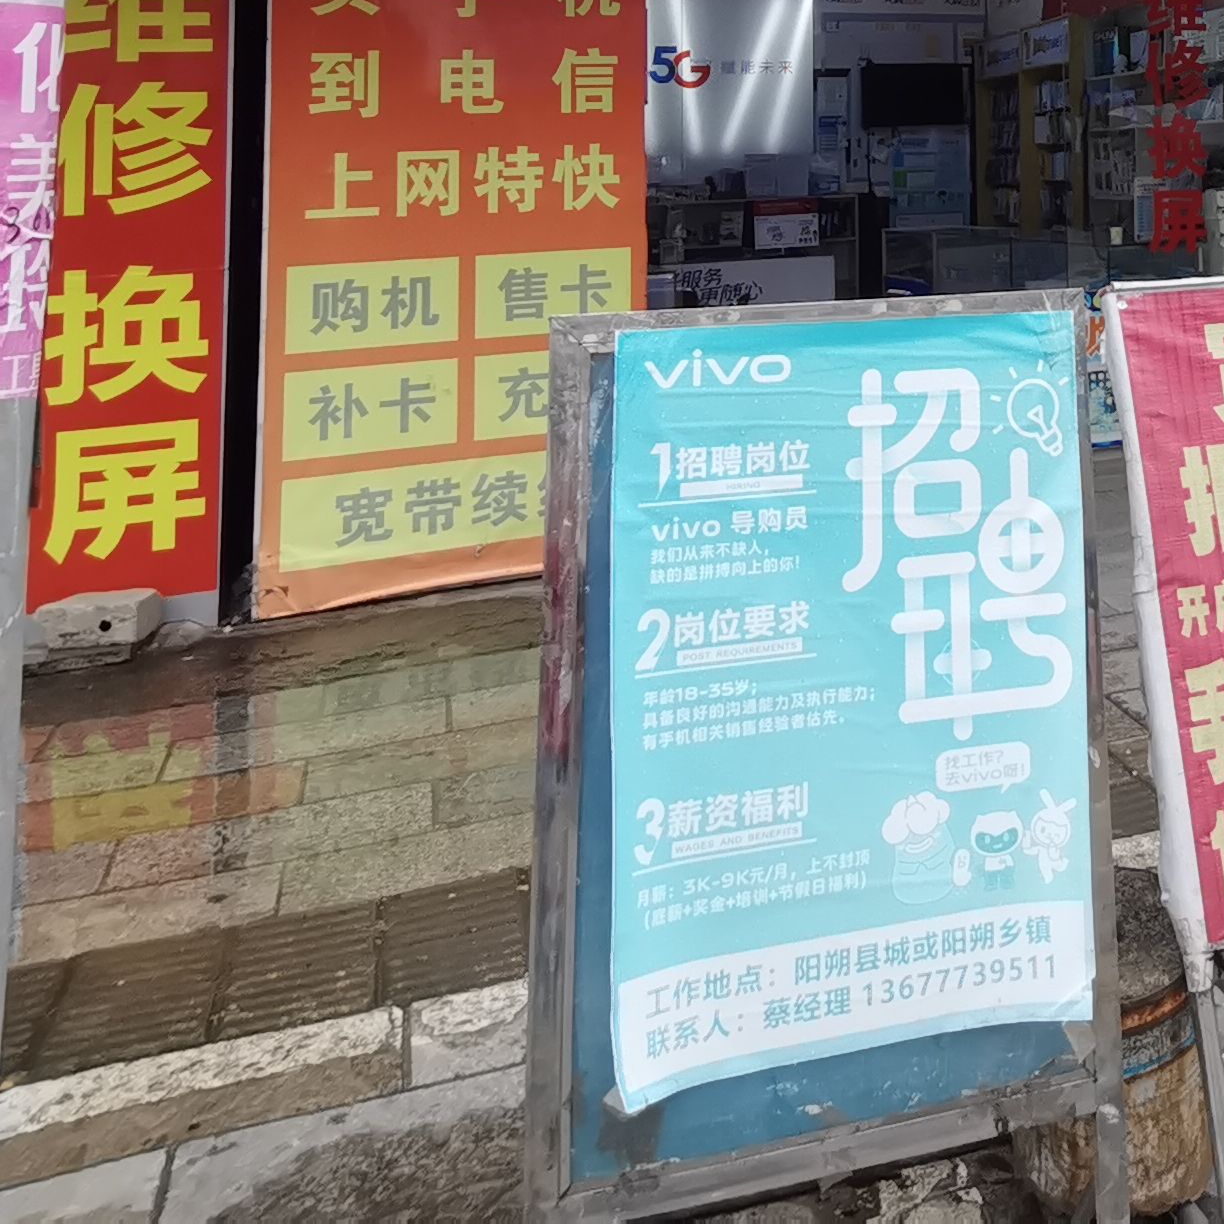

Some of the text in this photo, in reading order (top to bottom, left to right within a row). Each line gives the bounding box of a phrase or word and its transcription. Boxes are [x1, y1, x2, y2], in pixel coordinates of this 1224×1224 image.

[309, 47, 620, 118] 到电信
[649, 46, 711, 88] 5G
[304, 144, 622, 219] 上网特快
[309, 275, 441, 336] 购机
[498, 263, 612, 322] 售卡
[645, 349, 791, 389] vivo
[309, 382, 437, 441] 补卡
[334, 469, 549, 549] 宽带续
[651, 506, 808, 542] vivo 导购员
[842, 368, 1073, 741] 招聘
[682, 641, 798, 663] POST REQUIREMENTS
[674, 826, 799, 855] WAGES AND BENEFITS
[861, 955, 1058, 1008] 13677739511
